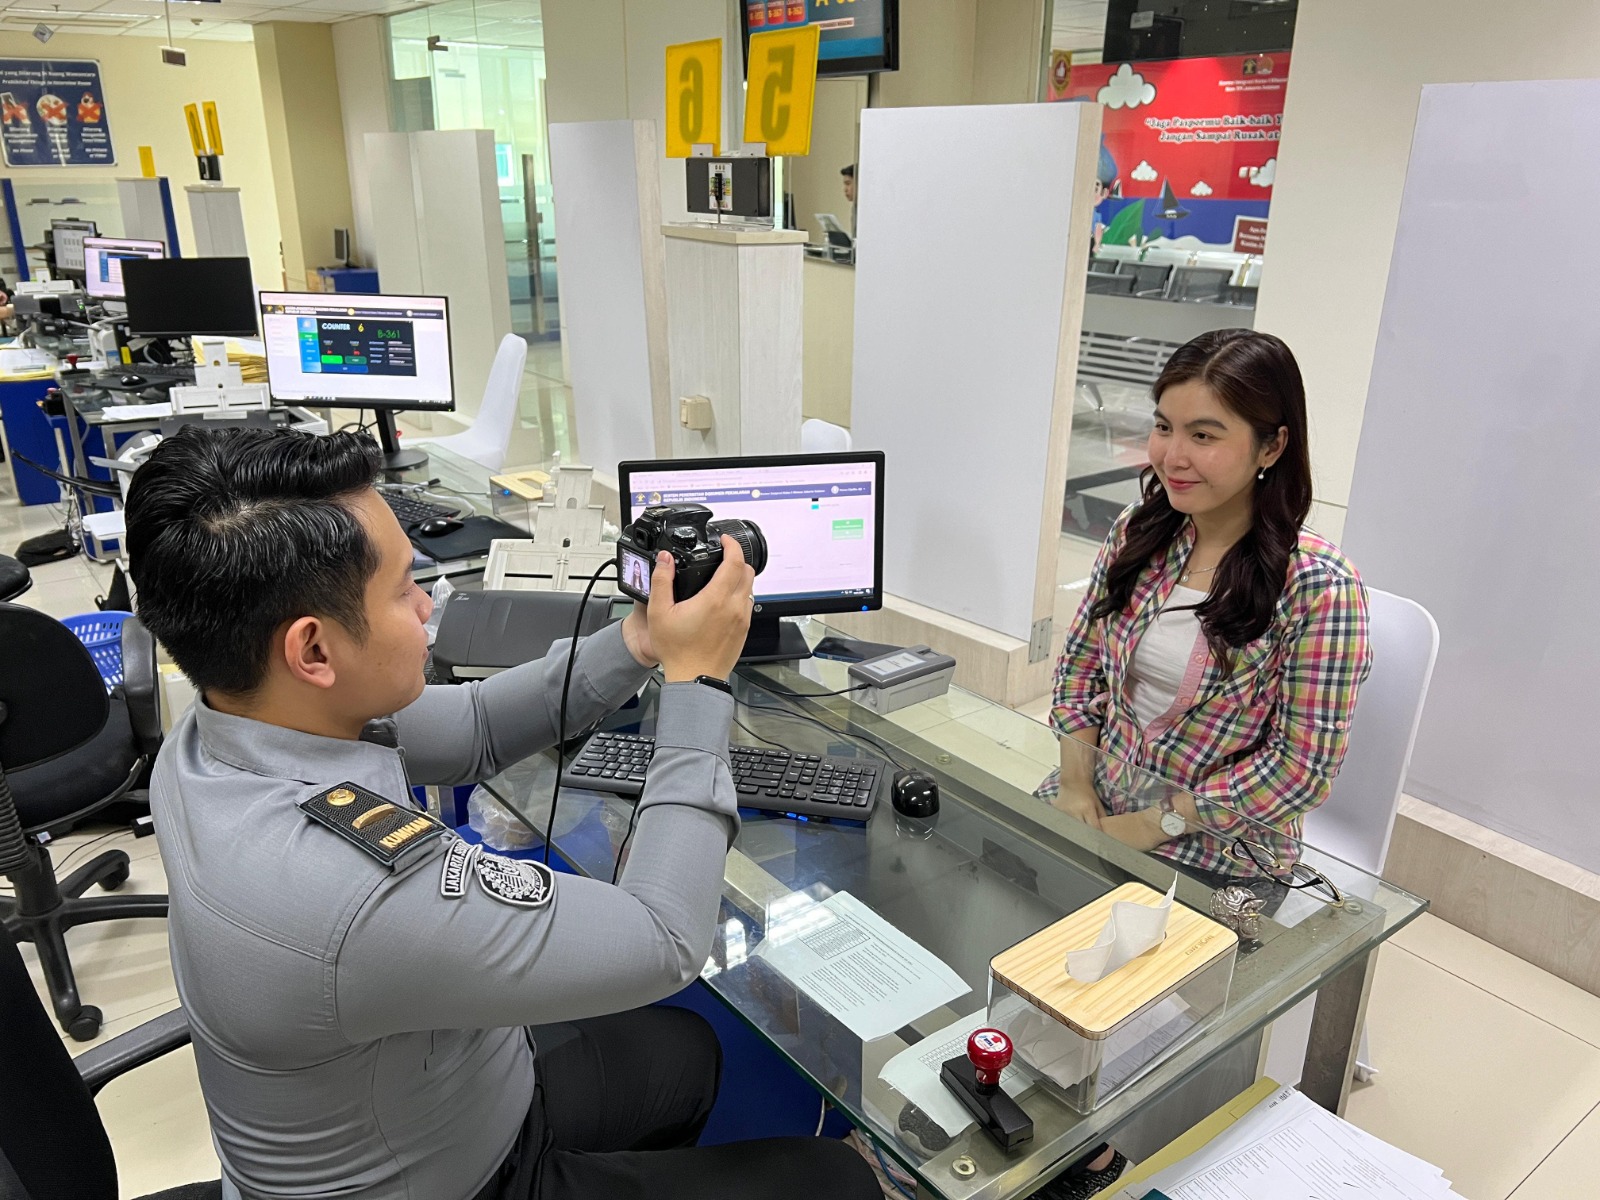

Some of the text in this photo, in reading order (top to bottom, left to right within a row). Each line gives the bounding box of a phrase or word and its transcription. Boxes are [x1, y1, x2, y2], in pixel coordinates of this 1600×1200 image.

[1159, 130, 1194, 143] Jangan
[1195, 130, 1232, 143] Sampai
[1233, 128, 1266, 141] Rusak
[321, 322, 364, 333] COUNTER 6
[377, 329, 400, 339] B-361
[446, 855, 465, 891] JAKARTA
